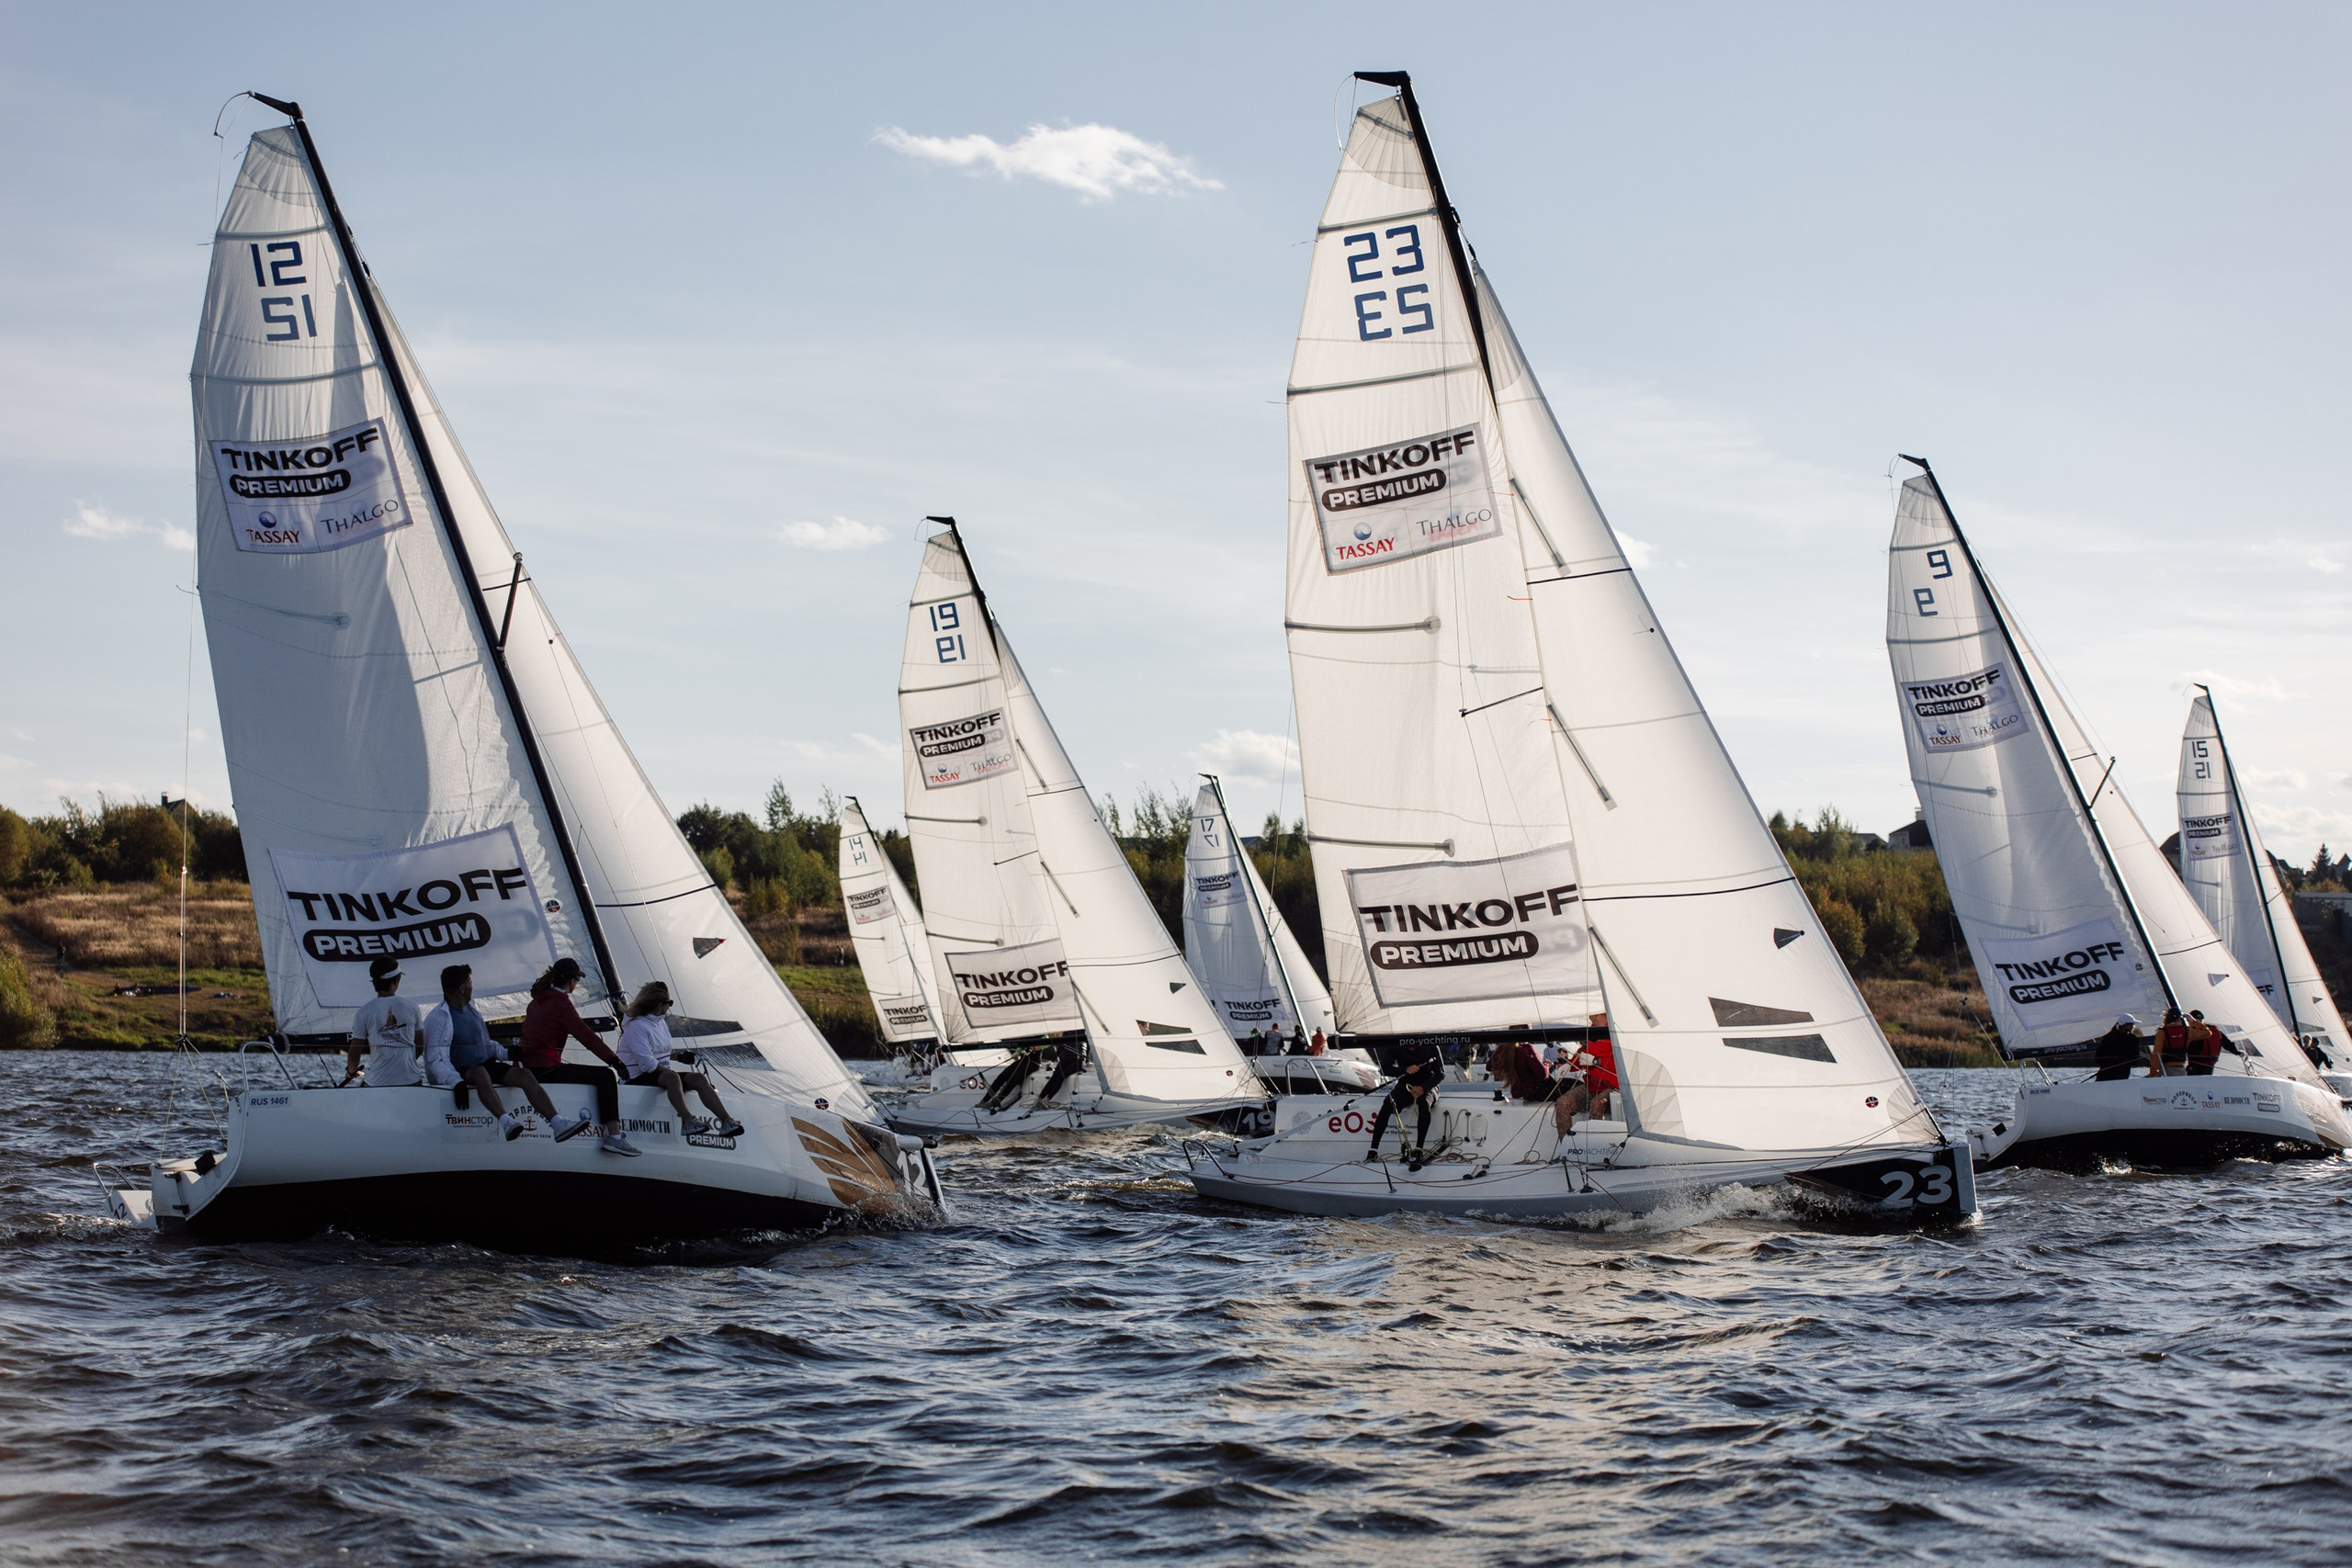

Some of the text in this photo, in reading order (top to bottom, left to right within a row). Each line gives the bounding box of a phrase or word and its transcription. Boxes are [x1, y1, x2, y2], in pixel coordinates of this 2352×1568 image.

[250, 241, 307, 288] 12
[1343, 224, 1425, 284] 23
[220, 426, 379, 472] TINKOFF
[1314, 430, 1475, 485] TINKOFF
[235, 473, 345, 495] PREMIUM
[1328, 473, 1440, 509] PREMIUM
[320, 499, 399, 535] THALGO
[1416, 508, 1492, 536] THALGO
[245, 528, 300, 544] TASSAY
[1336, 537, 1396, 560] TASSAY
[1927, 549, 1953, 580] 9
[929, 602, 960, 632] 19
[1907, 669, 2001, 700] TINKOFF
[1917, 697, 1982, 716] PREMIUM
[915, 712, 1001, 743] TINKOFF
[1971, 714, 2019, 738] THALGO
[923, 735, 982, 756] PREMIUM
[1929, 735, 1962, 746] TASSAY
[2191, 740, 2209, 759] 15
[970, 753, 1012, 773] THALGO
[930, 772, 960, 784] TASSAY
[1200, 818, 1215, 832] 17
[2184, 815, 2232, 829] TINKOFF
[849, 836, 863, 851] 14
[2188, 829, 2219, 838] PREMIUM
[1196, 872, 1238, 885] TINKOFF
[1199, 883, 1230, 892] PREMIUM
[287, 866, 528, 923] TINKOFF
[850, 887, 886, 902] TINKOFF
[1357, 883, 1579, 932] TINKOFF
[312, 919, 481, 955] PREMIUM
[1378, 936, 1528, 964] PREMIUM
[1995, 942, 2125, 982] TINKOFF
[955, 960, 1069, 989] TINKOFF
[968, 988, 1048, 1006] PREMIUM
[2013, 973, 2106, 1001] PREMIUM
[1224, 998, 1281, 1011] TINKOFF
[890, 1016, 925, 1024] PREMIUM
[1231, 1012, 1271, 1021] PREMIUM
[1399, 1035, 1470, 1047] pro-yachting.ru
[250, 1097, 288, 1106] RUS 1461
[2252, 1092, 2281, 1102] TINKOFF
[1242, 1111, 1275, 1131] 19
[689, 1134, 734, 1148] PREMIUM
[897, 1150, 931, 1197] 12
[1880, 1165, 1952, 1208] 23
